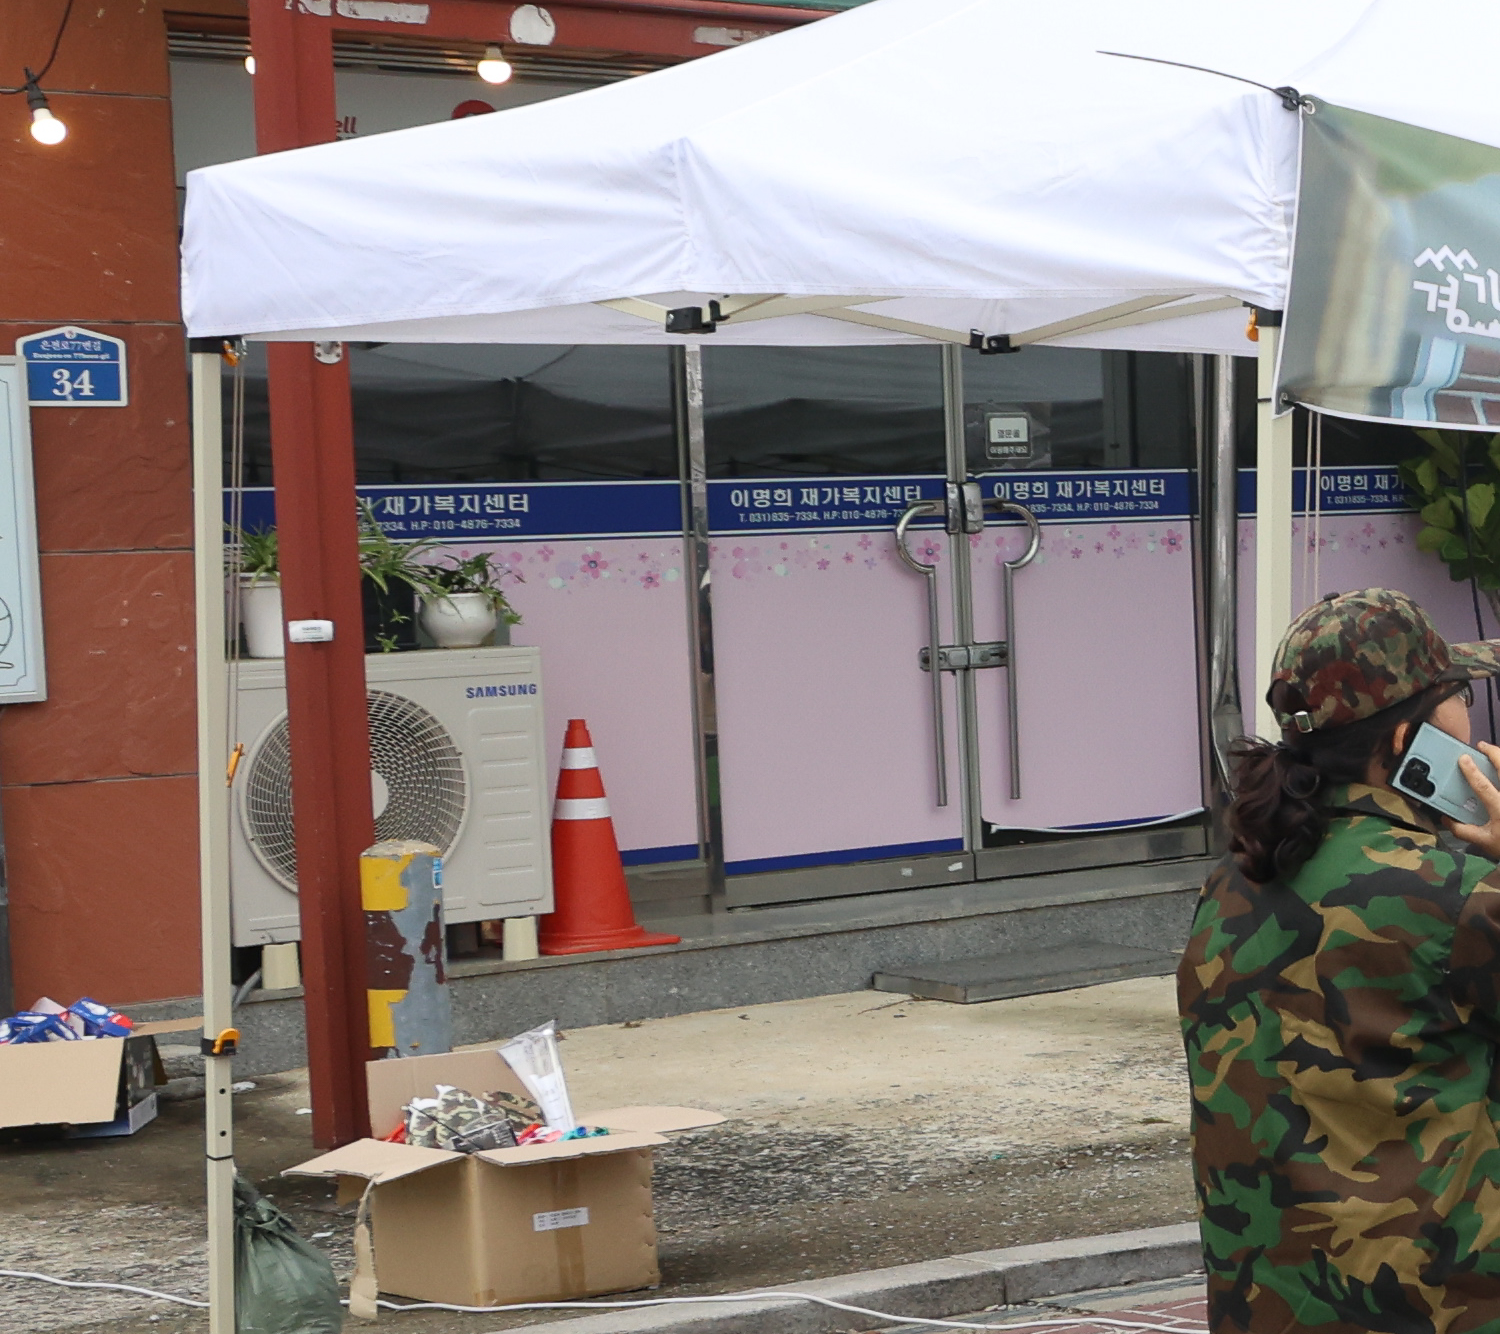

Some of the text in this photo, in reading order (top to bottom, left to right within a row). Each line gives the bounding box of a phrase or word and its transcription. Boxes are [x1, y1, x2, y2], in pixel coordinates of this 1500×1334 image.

[51, 368, 95, 397] 34
[993, 477, 1167, 501] 이명희 재가복지센터
[1320, 473, 1369, 493] 이명희
[382, 492, 530, 516] 재가복지센터
[730, 483, 922, 508] 이명희 재가복지센터
[465, 683, 538, 699] SAMSUNG
